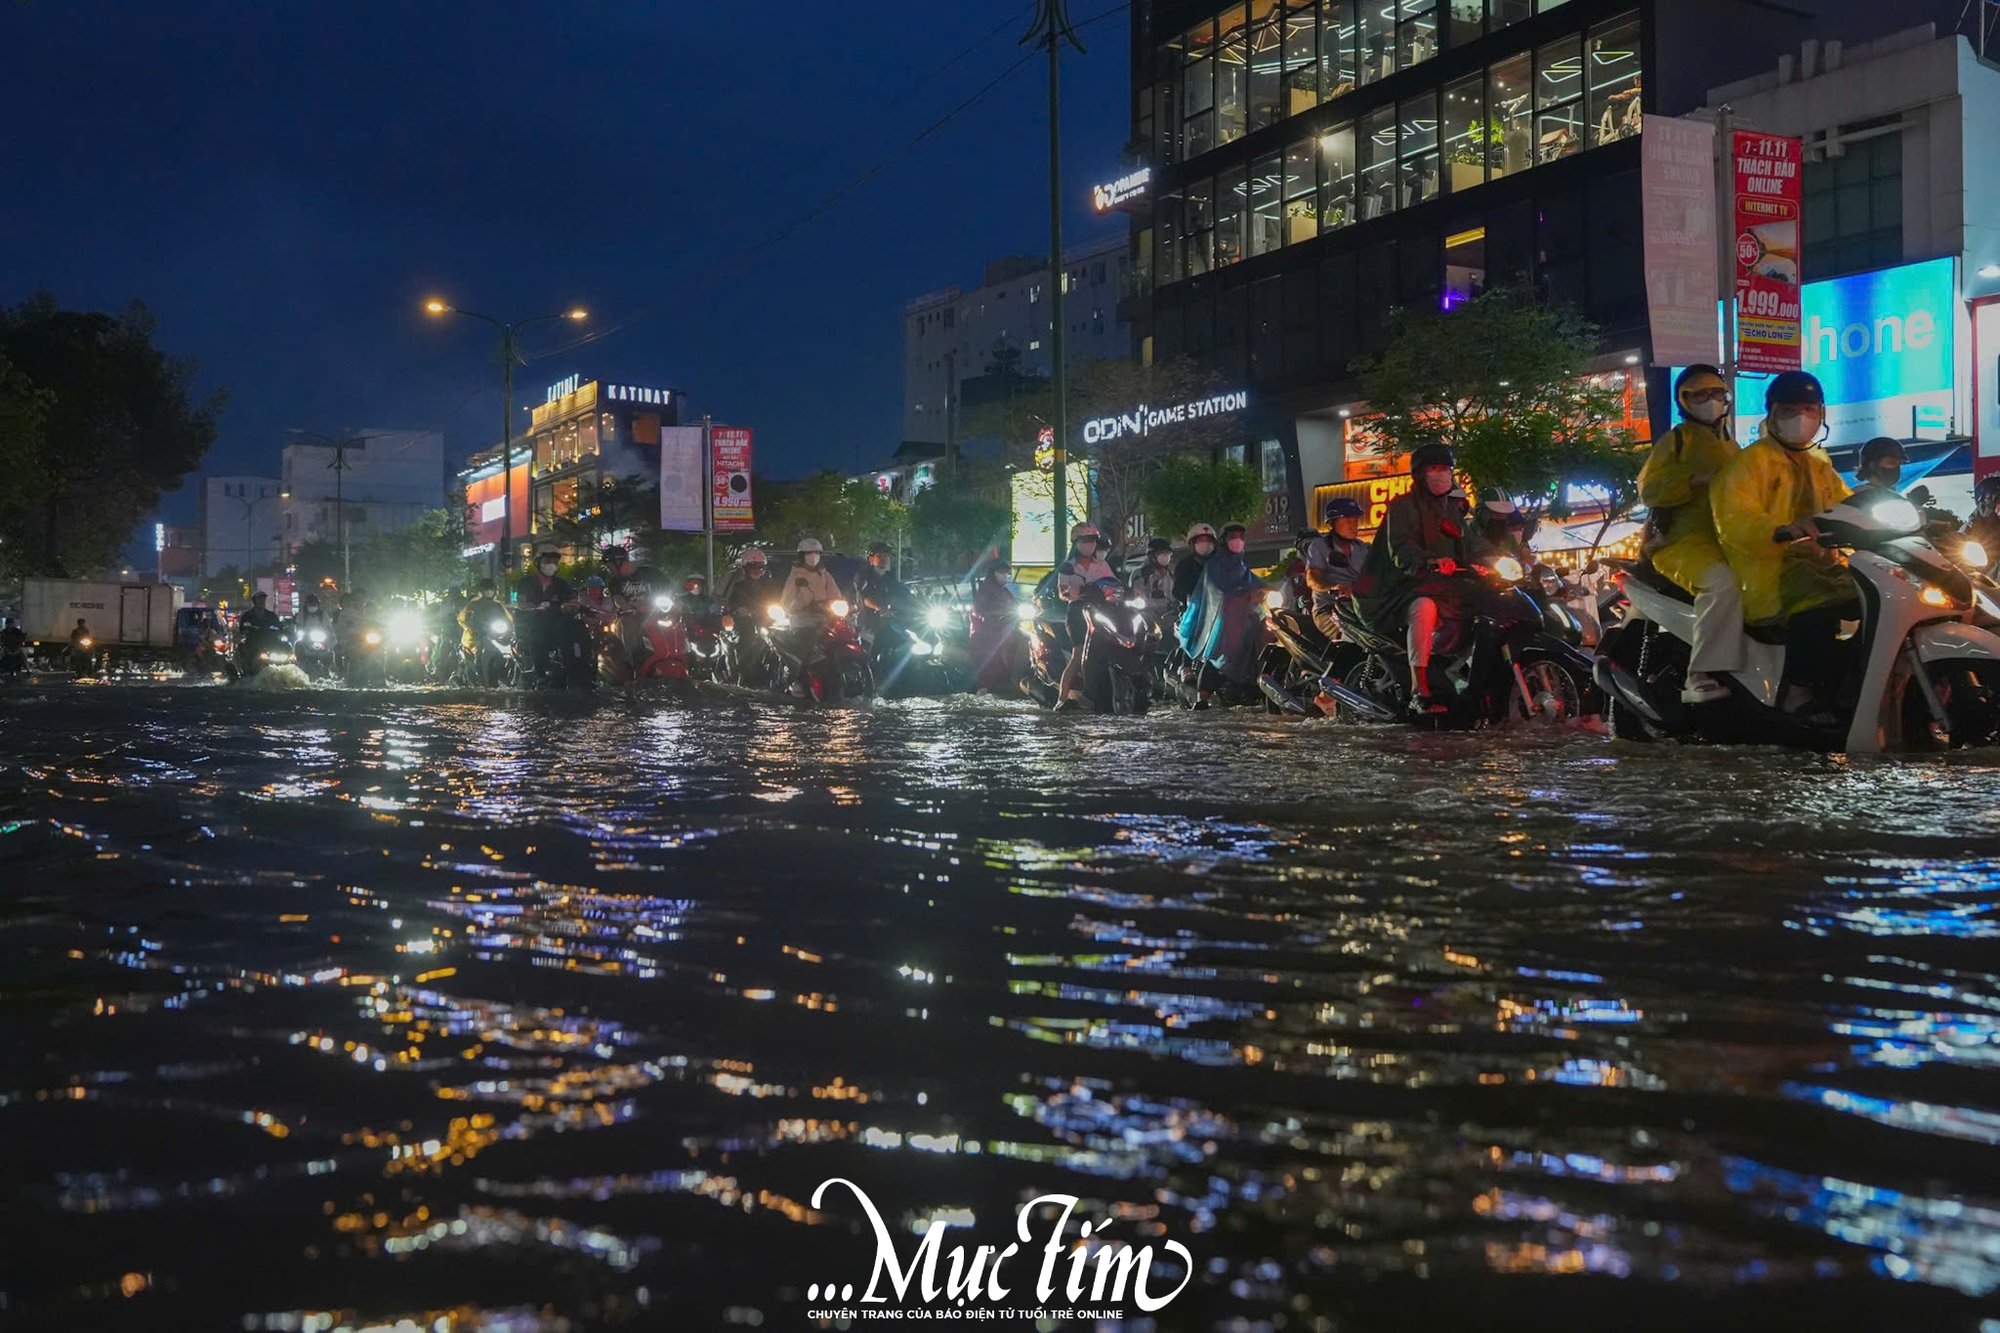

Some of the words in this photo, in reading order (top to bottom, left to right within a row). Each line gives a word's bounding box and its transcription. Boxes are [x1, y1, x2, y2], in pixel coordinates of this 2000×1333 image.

[1759, 139, 1788, 158] 11.11
[1738, 156, 1772, 176] THÁCH
[1747, 176, 1784, 195] ONLINE
[1745, 201, 1778, 215] INTERNET
[1779, 205, 1789, 217] TV
[1737, 289, 1799, 318] 1.999.000
[1801, 308, 1936, 365] hone
[1148, 404, 1186, 428] GAME
[1187, 391, 1247, 419] STATION
[717, 460, 745, 468] HITACHI
